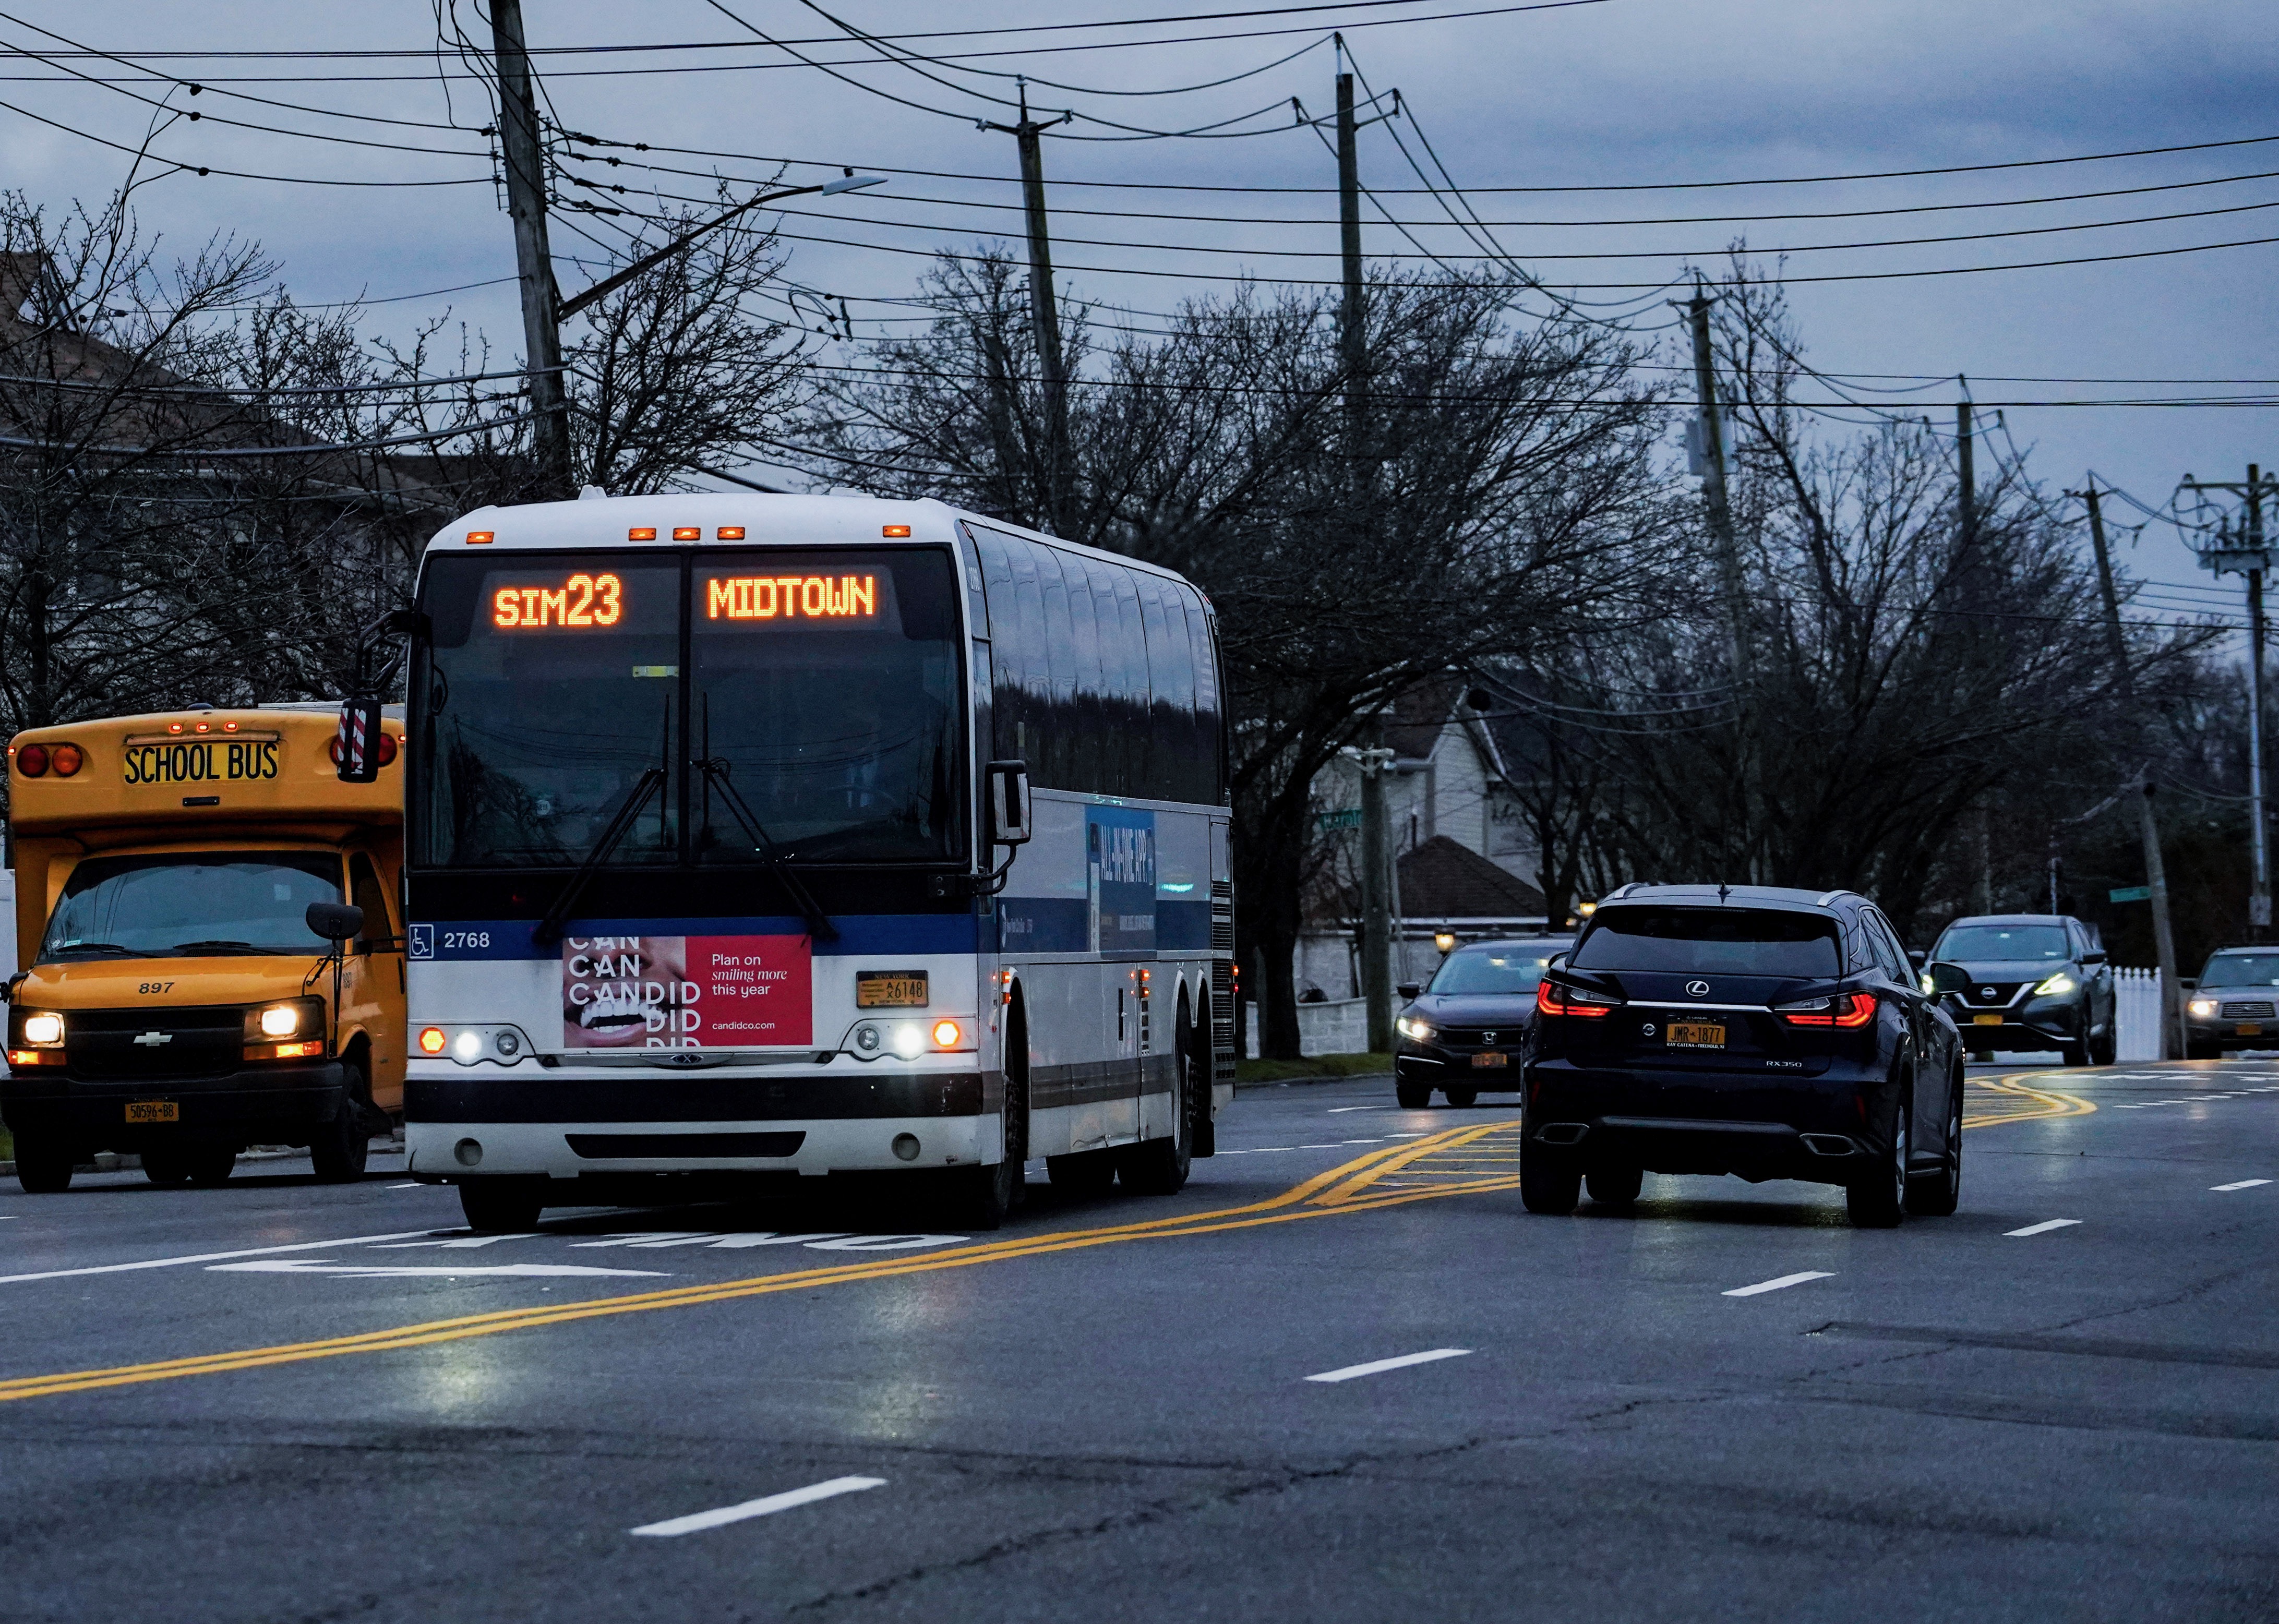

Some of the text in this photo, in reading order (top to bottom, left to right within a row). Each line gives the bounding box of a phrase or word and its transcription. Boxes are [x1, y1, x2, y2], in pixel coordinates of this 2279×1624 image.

[496, 575, 619, 625] SIM23
[710, 577, 873, 617] MIDTOWN
[125, 742, 278, 784] SCHOOL BUS
[445, 932, 489, 947] 2768
[569, 955, 639, 977] CAN
[712, 954, 761, 965] Plan on
[712, 969, 787, 982] smiling more
[139, 982, 175, 994] 897
[569, 981, 700, 1005] CANDID
[712, 984, 771, 998] this year
[646, 1009, 701, 1032] DID
[712, 1021, 775, 1030] candidco.com
